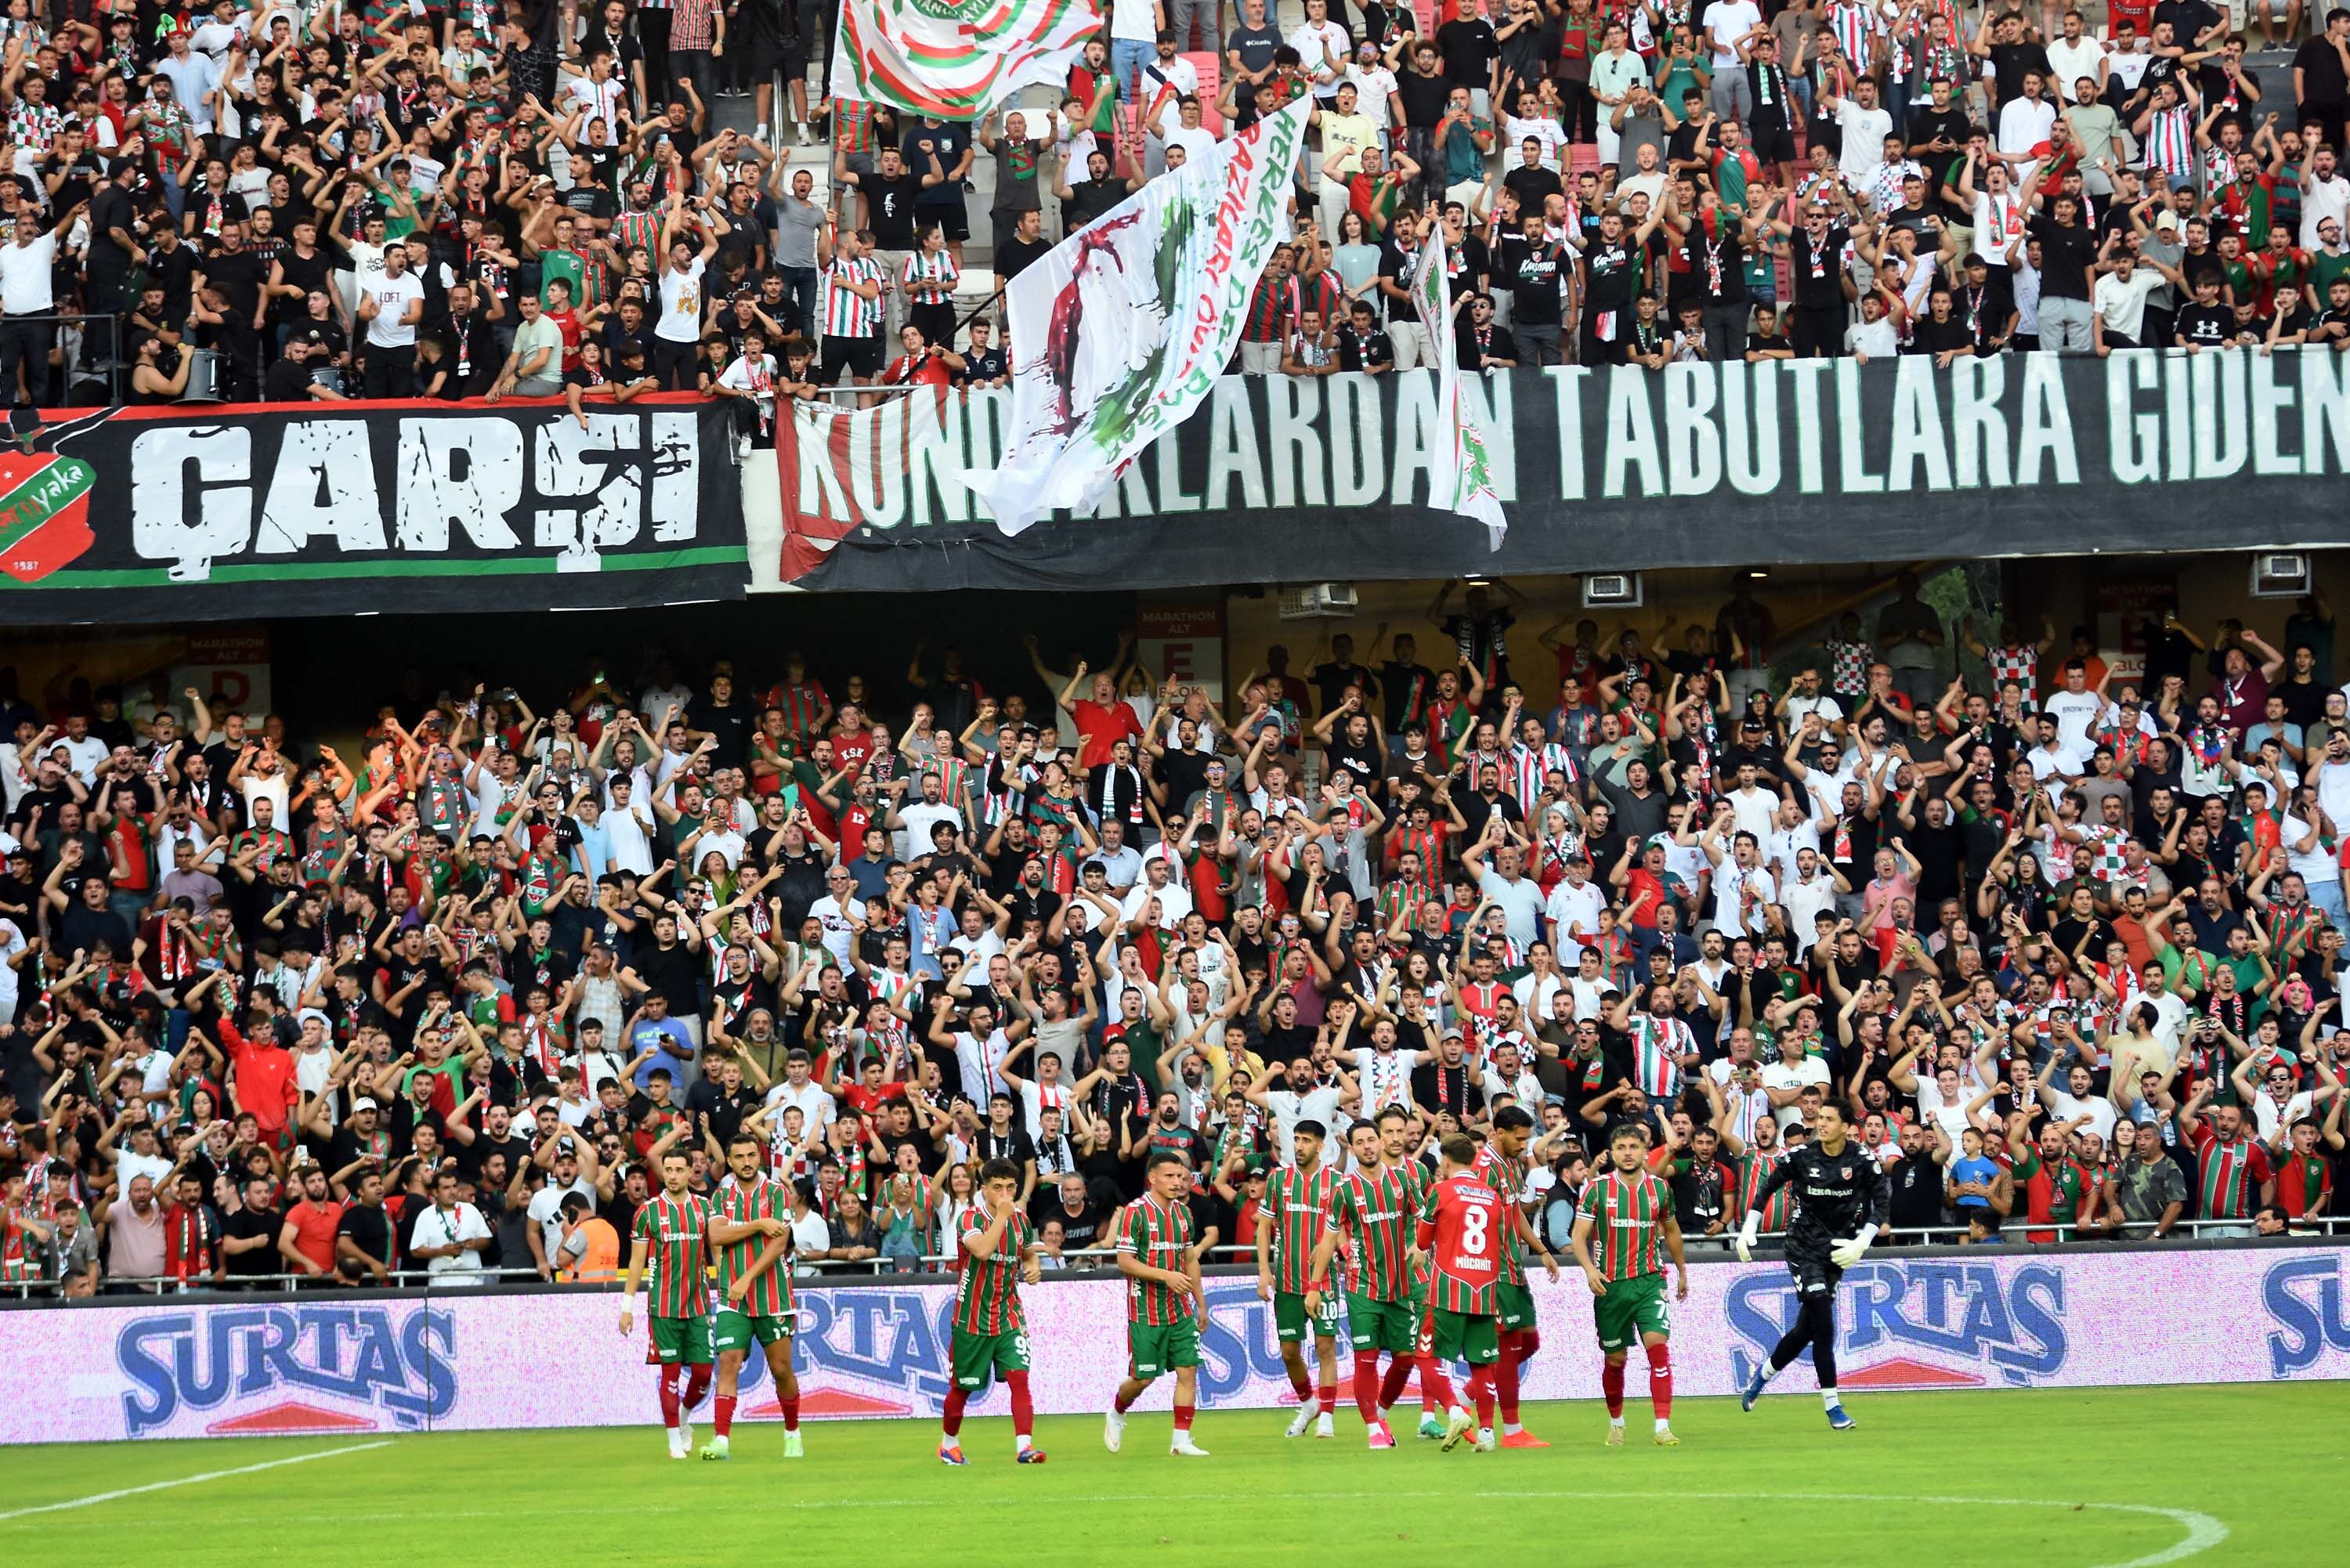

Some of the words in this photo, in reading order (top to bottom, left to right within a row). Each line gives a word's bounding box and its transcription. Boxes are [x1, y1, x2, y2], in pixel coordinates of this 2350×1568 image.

[1241, 109, 1297, 269] HERKES
[379, 292, 400, 302] LOFT
[794, 367, 1518, 529] KUNDLARDAN
[1542, 351, 2080, 500] TABUTLARA
[1142, 612, 1216, 621] MARATHON
[1168, 624, 1191, 634] ALT
[191, 638, 265, 649] MARATHON
[217, 651, 239, 660] ALT
[1164, 644, 1194, 681] E
[212, 670, 251, 708] D
[841, 747, 865, 761] KSK
[852, 812, 865, 825] 12
[1463, 1205, 1488, 1255] 8
[1455, 1255, 1492, 1272] MÜCAHİT
[1321, 1302, 1338, 1321] 10
